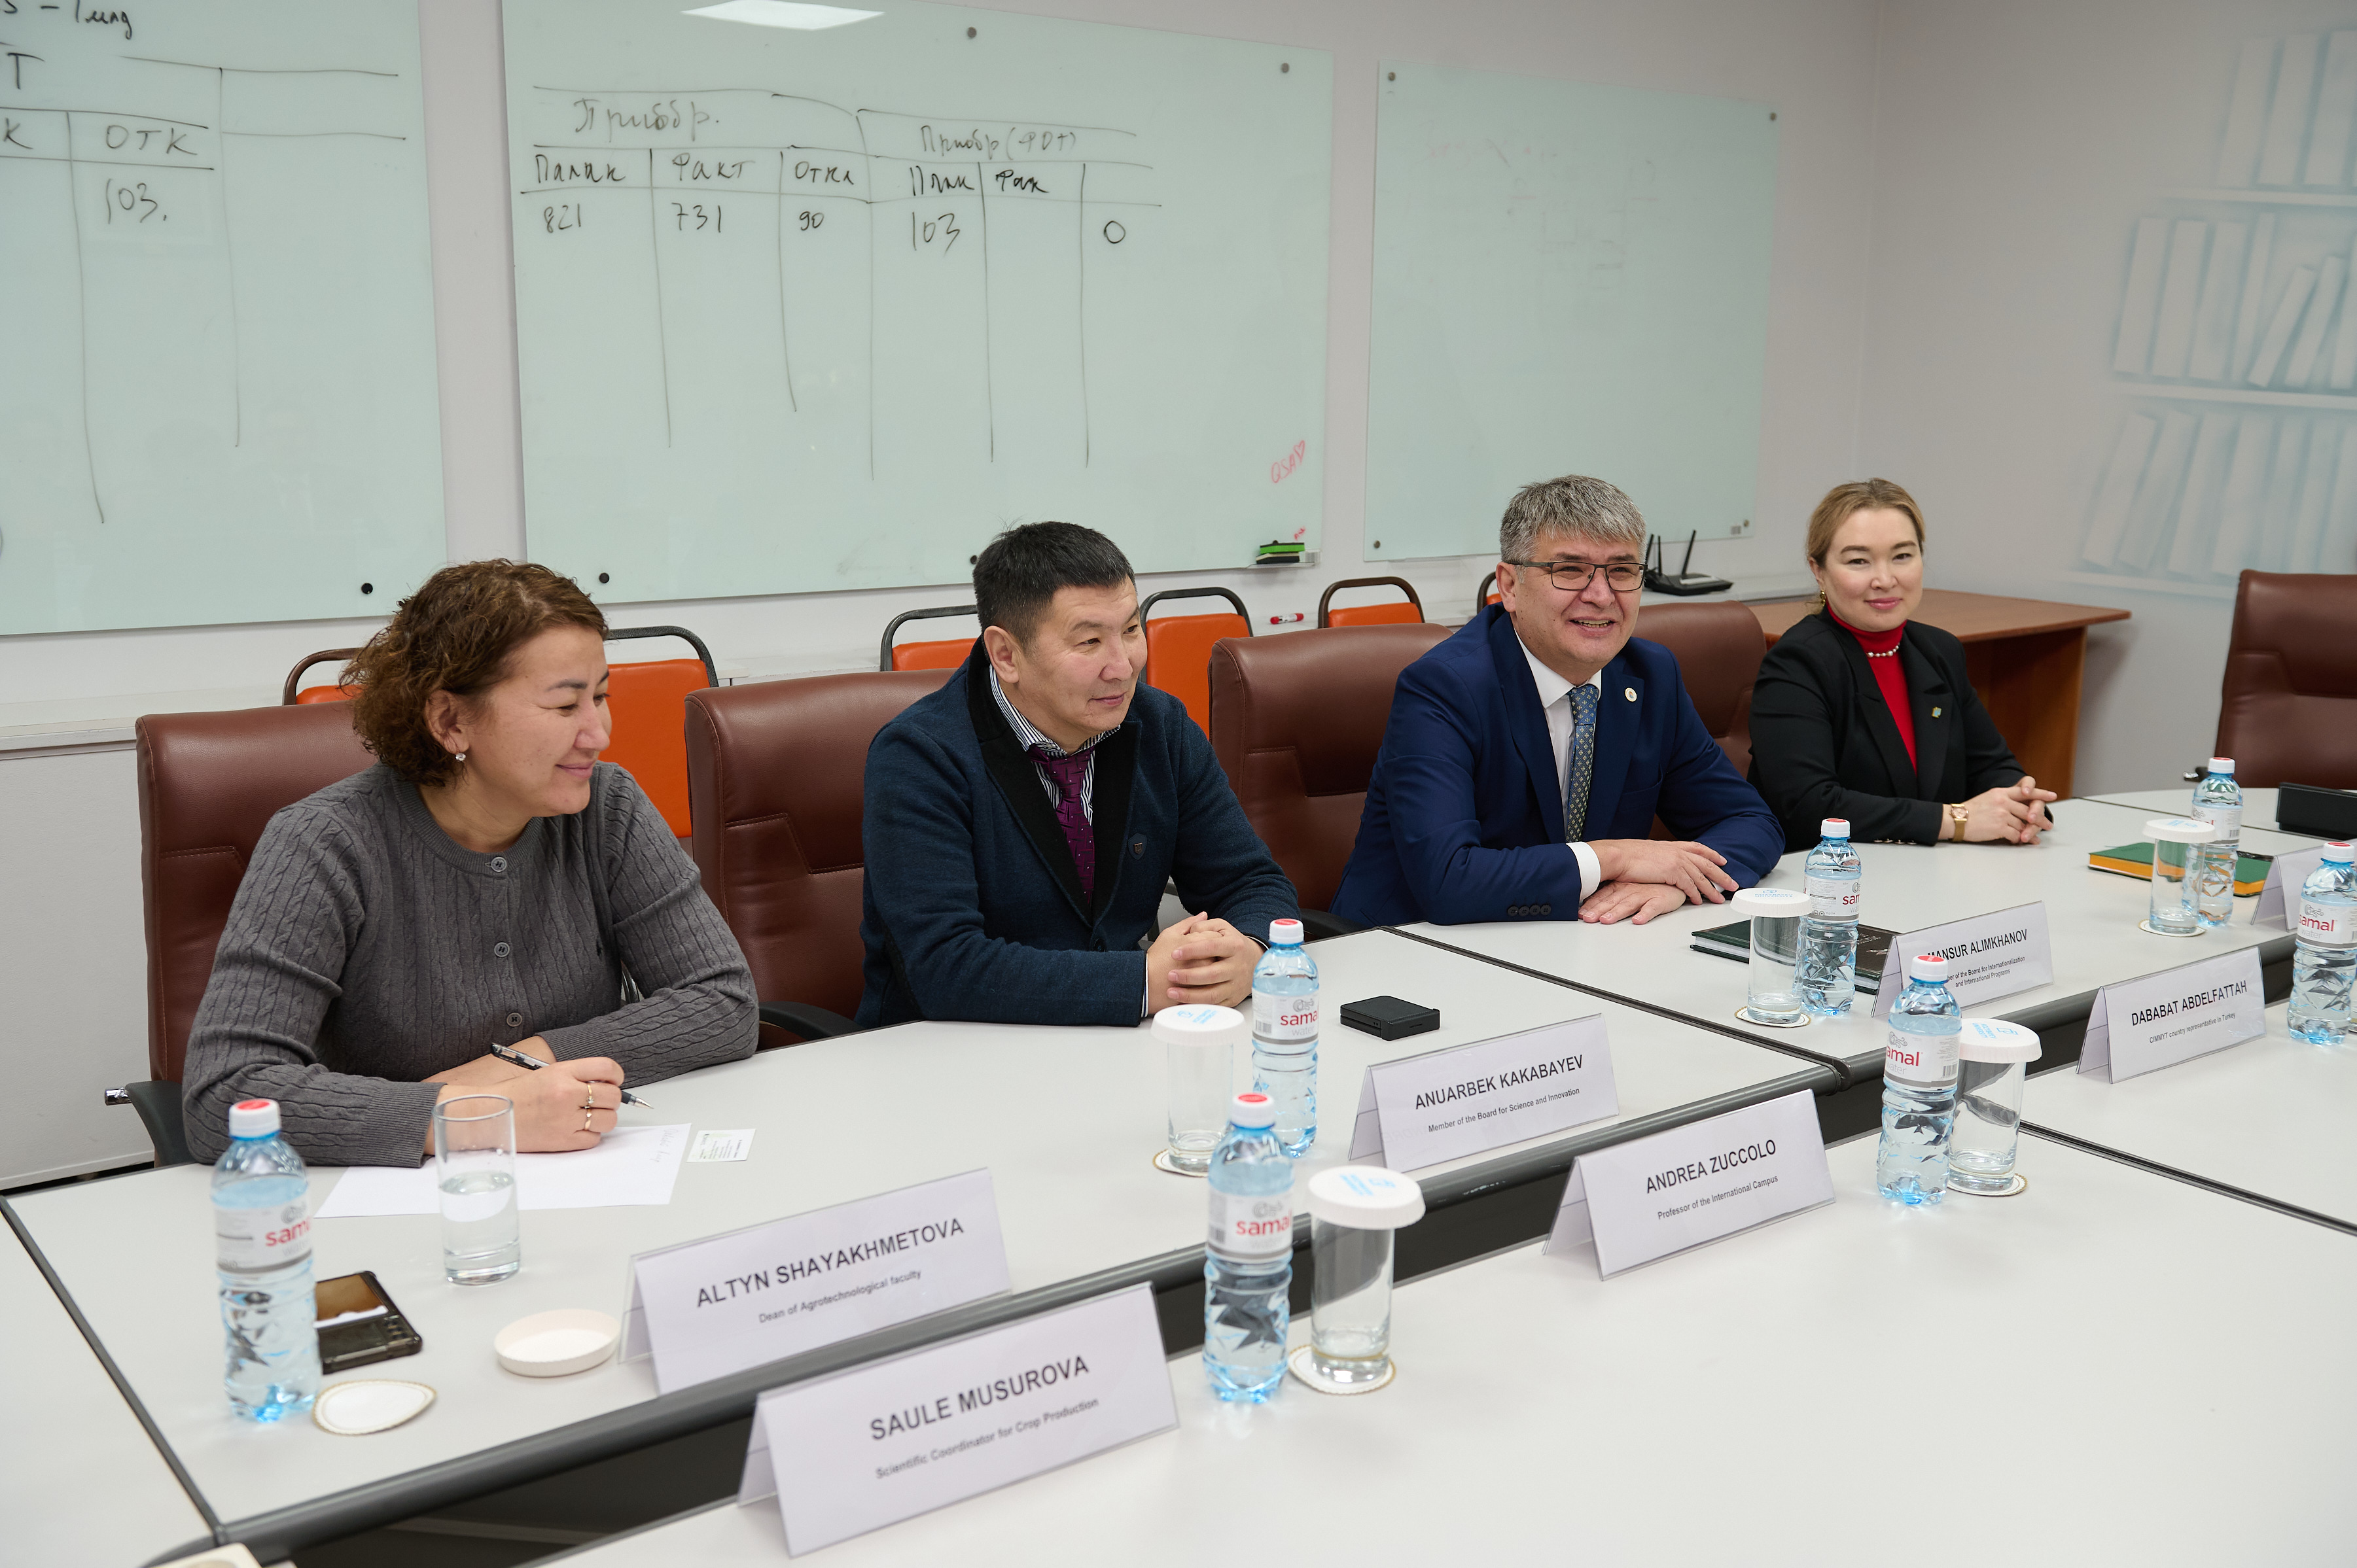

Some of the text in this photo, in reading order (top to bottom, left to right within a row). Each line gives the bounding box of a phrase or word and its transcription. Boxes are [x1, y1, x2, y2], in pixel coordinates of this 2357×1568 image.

[544, 203, 582, 233] 821
[671, 201, 721, 233] 731
[799, 211, 824, 231] 90
[912, 211, 961, 254] 103
[1970, 928, 2028, 954] ALIMKHANOV
[1964, 973, 1991, 983] International
[1991, 968, 2011, 979] Programs
[1968, 967, 1981, 976] Board
[1988, 956, 2025, 970] Internationalization
[2131, 981, 2247, 1026] DABABAT ABDELFATTAH
[2150, 1032, 2168, 1043] CIMMYT
[2169, 1027, 2186, 1039] country
[2186, 1018, 2216, 1033] representative
[2222, 1012, 2236, 1021] Turkey
[1887, 1045, 1920, 1066] amal
[1415, 1054, 1584, 1109] ANUARBEK KAKABAYEV
[1428, 1119, 1455, 1133] Member
[1457, 1117, 1464, 1126] of
[1465, 1114, 1476, 1124] the
[1477, 1109, 1497, 1121] Board
[1498, 1106, 1508, 1115] for
[1509, 1100, 1534, 1112] Science
[1535, 1095, 1547, 1106] and
[1548, 1087, 1580, 1102] Innovation
[1646, 1139, 1777, 1194] ANDREA ZUCCOLO
[1657, 1175, 1779, 1220] Professor of the International Campus
[697, 1217, 965, 1308] ALTYN SHAYAKHMETOVA
[759, 1269, 921, 1323] Dean of Agrotechnological faculty
[870, 1355, 1090, 1441] SAULE MUSUROVA
[876, 1398, 1099, 1479] Scientific Coordinator for Crop Production
